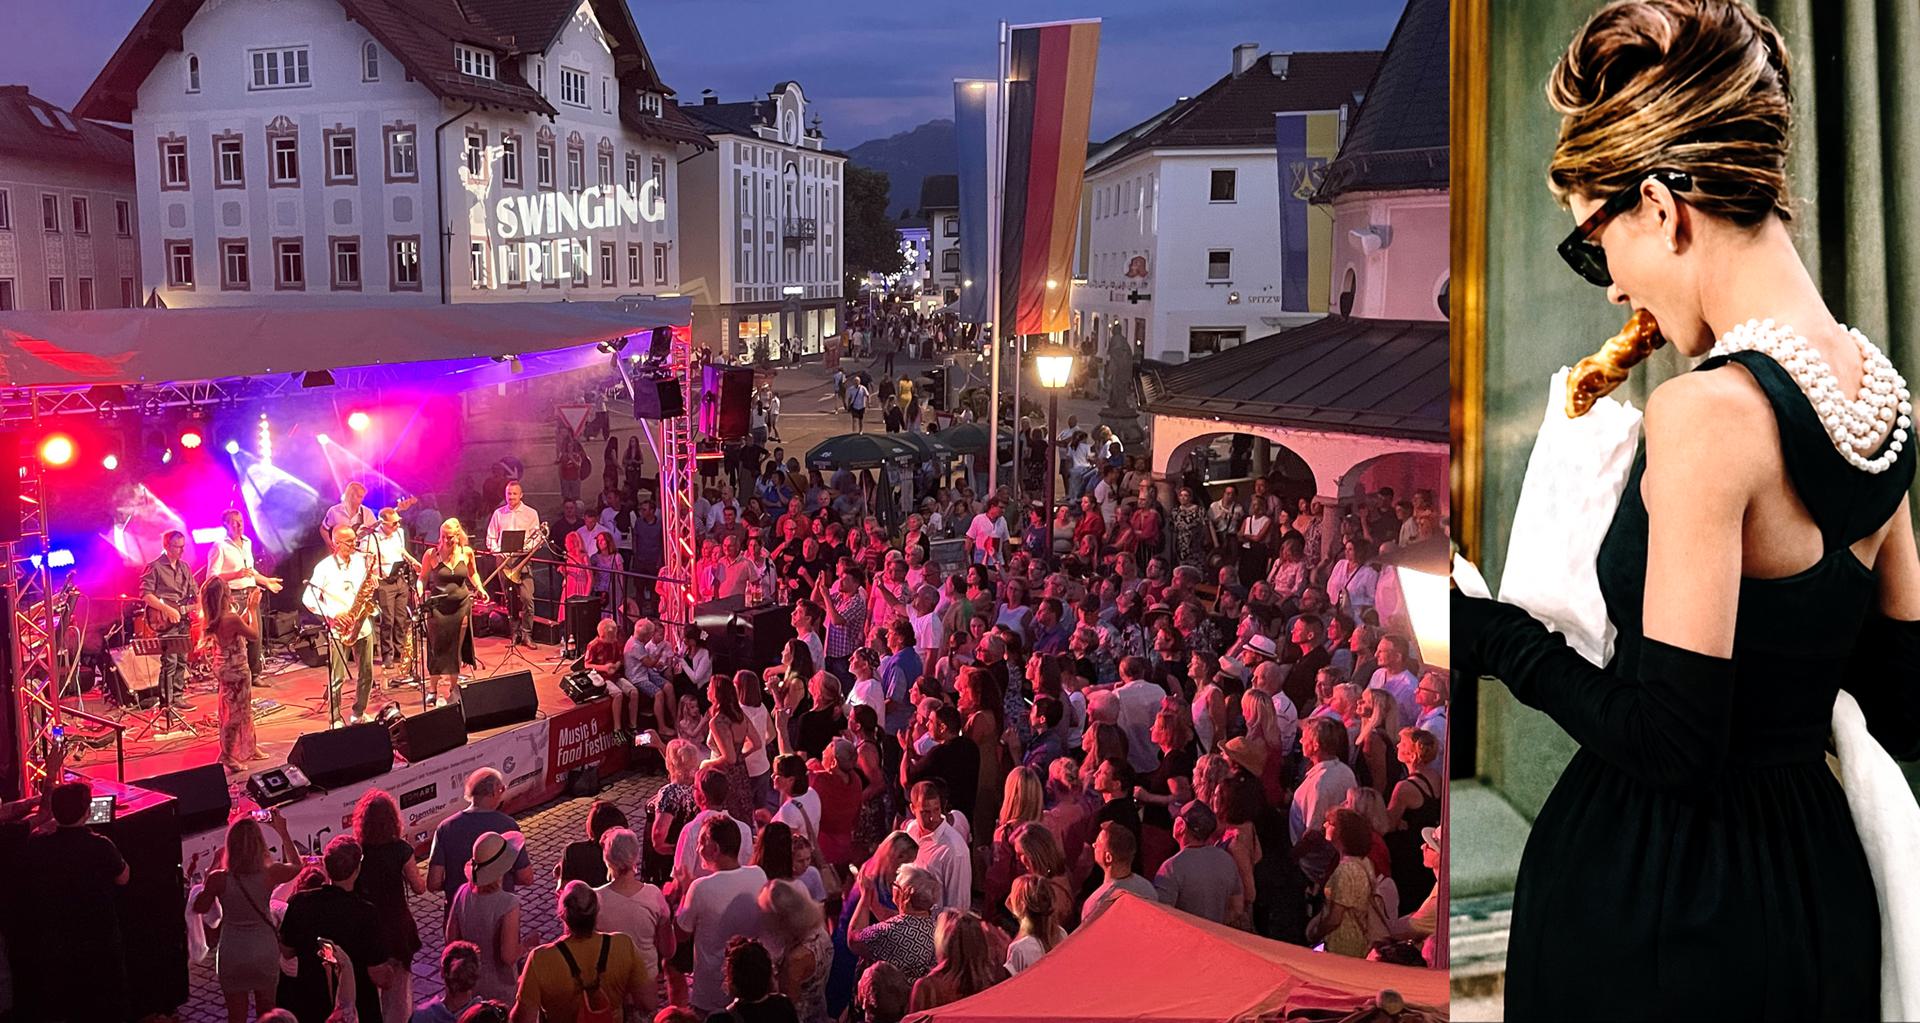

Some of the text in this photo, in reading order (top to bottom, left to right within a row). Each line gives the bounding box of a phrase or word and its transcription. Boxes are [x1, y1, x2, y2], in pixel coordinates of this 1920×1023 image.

[496, 176, 665, 239] SWINGING
[559, 721, 590, 748] Music
[584, 730, 619, 758] Festiva
